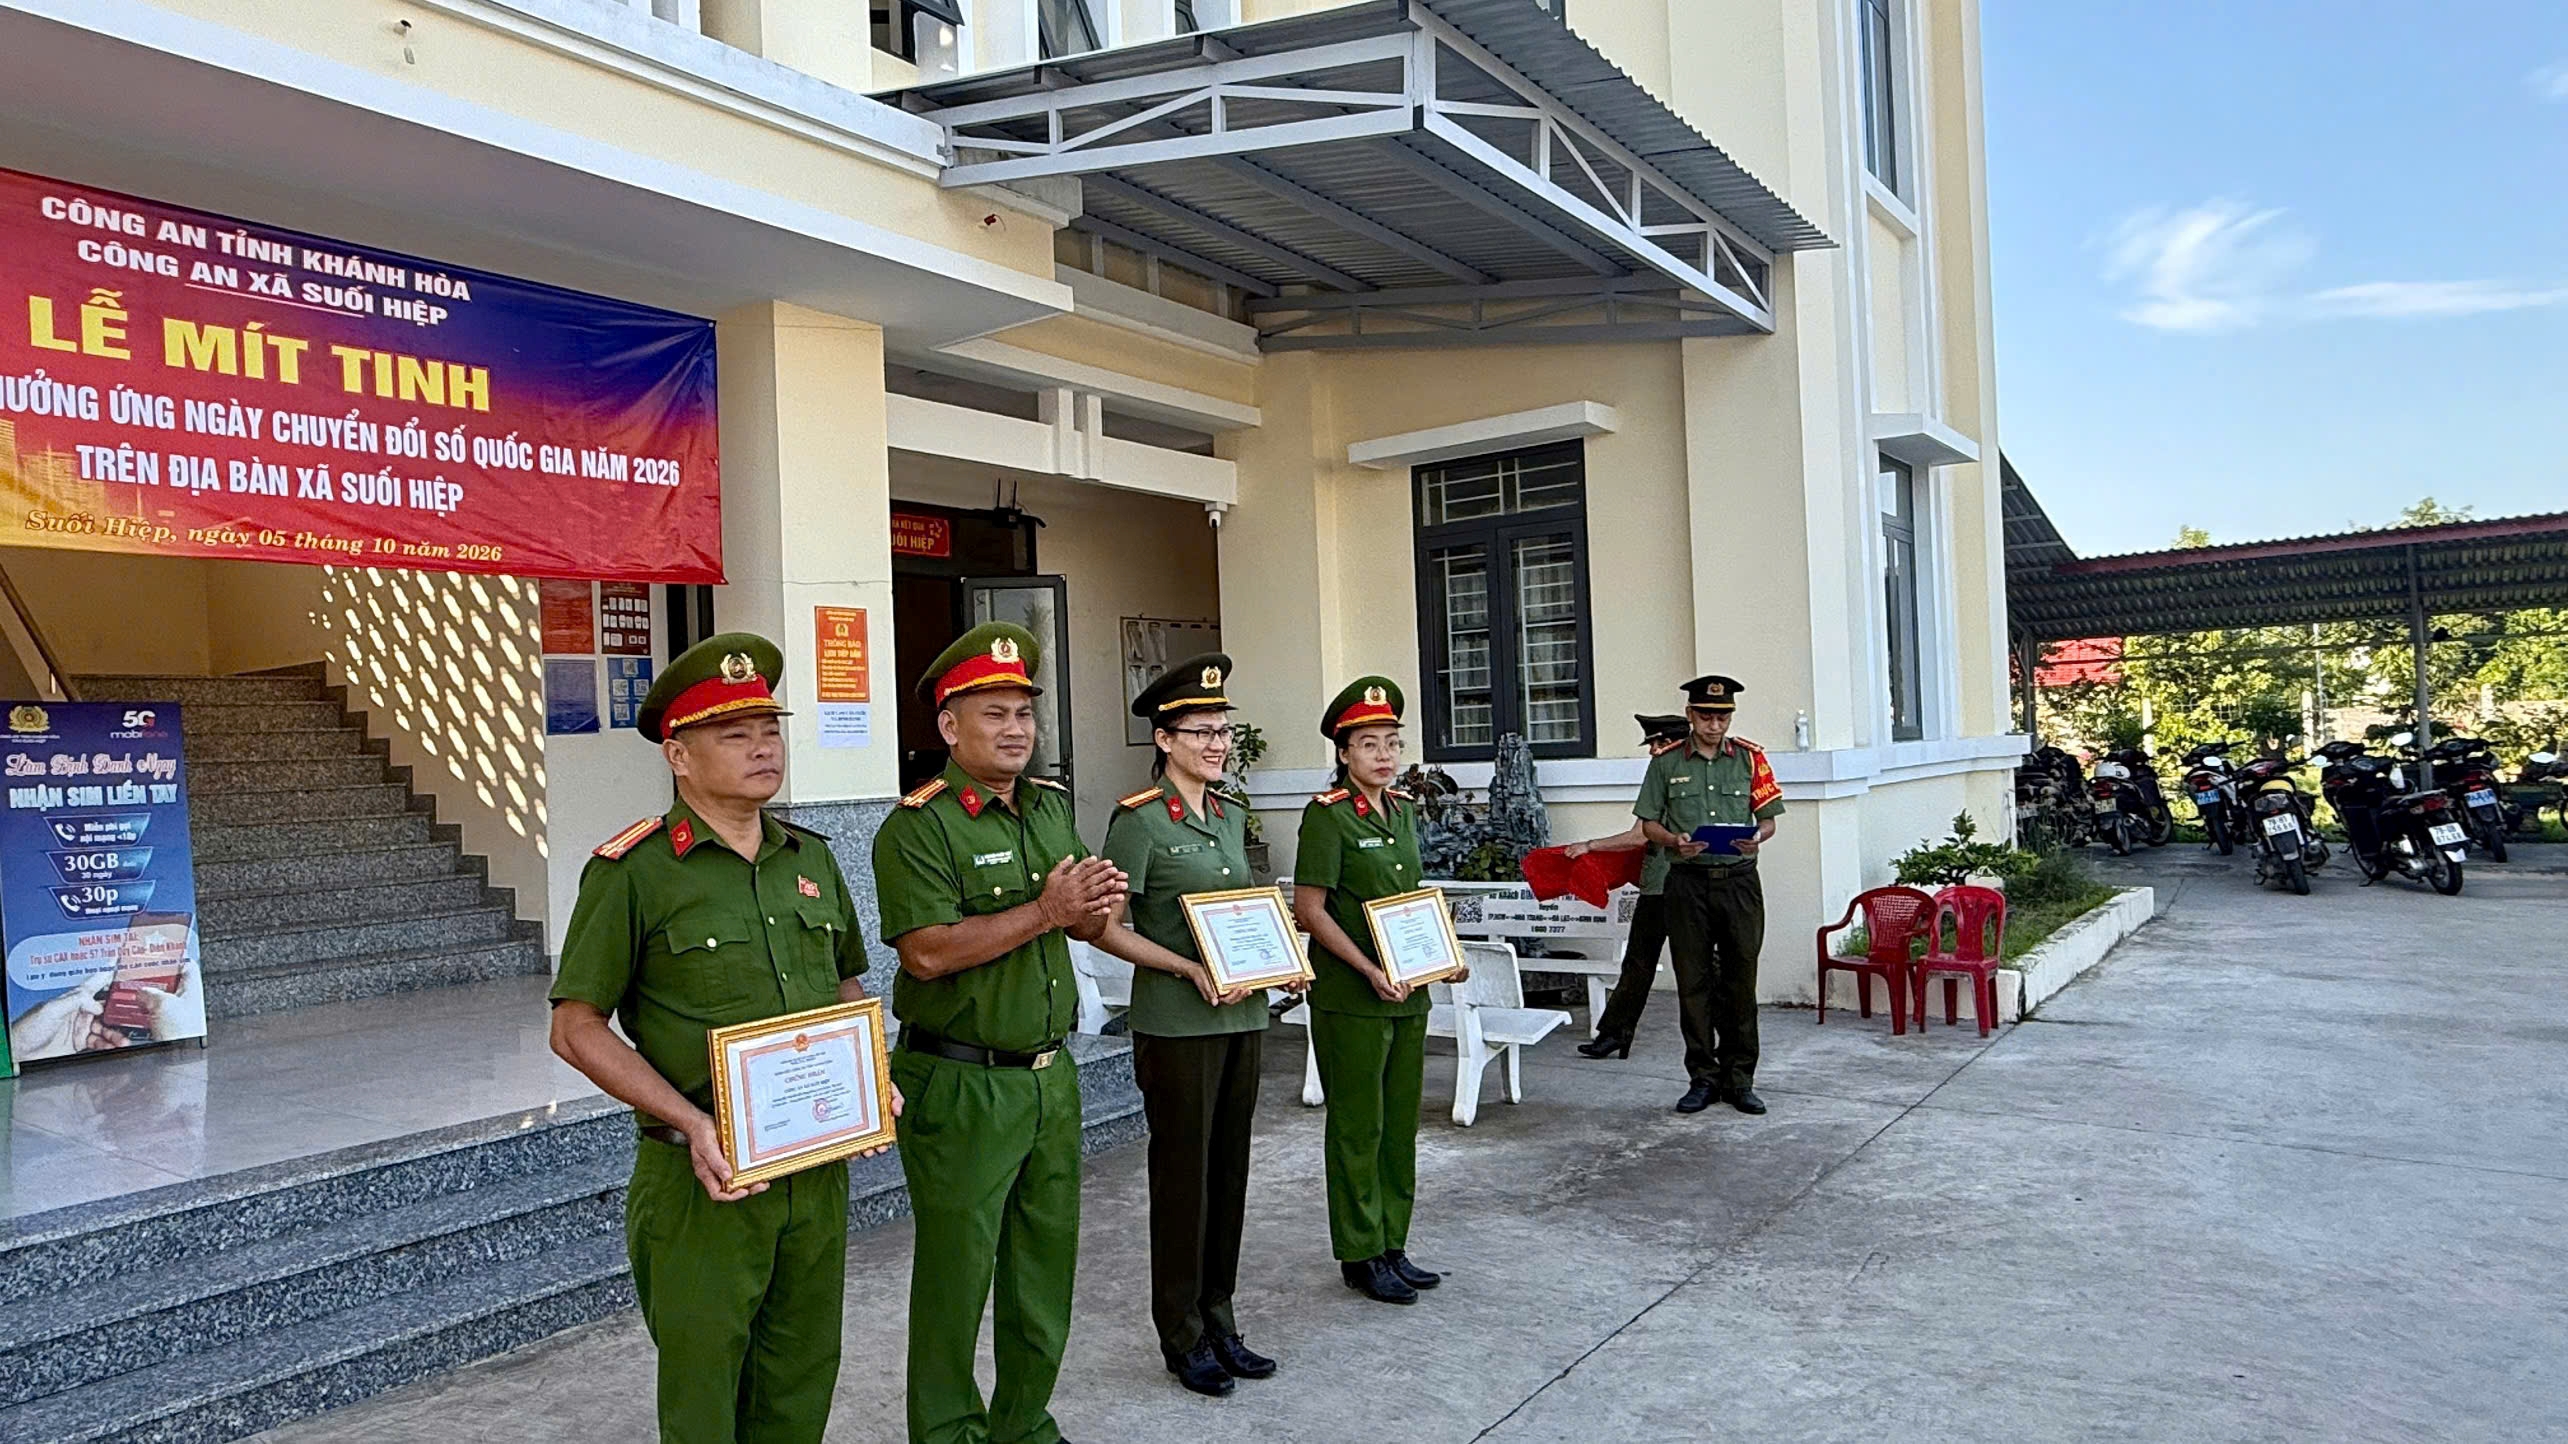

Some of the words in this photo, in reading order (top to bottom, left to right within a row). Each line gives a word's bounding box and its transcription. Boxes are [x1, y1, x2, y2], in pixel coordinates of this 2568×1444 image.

[41, 196, 146, 237] CÔNG
[156, 220, 207, 249] AN
[216, 229, 292, 266] TỈNH
[302, 249, 406, 289] KHÁNH
[414, 271, 472, 302] HÒA
[77, 239, 180, 278] CÔNG
[190, 261, 238, 288] AN
[248, 271, 294, 299] XÃ
[302, 281, 374, 314] SUỐI
[383, 296, 448, 327] HIỆP
[29, 287, 131, 360] LỄ
[163, 317, 309, 385] MÍT
[331, 344, 489, 412] TINH
[0, 368, 100, 421] ƯỞNG
[109, 383, 175, 430] ỨNG
[184, 398, 264, 440] NGÀY
[272, 408, 378, 454] CHUYỂN
[385, 416, 428, 459] ĐỔI
[434, 423, 466, 463] SỐ
[473, 431, 534, 471] QUỐC
[539, 444, 576, 477] GIA
[581, 446, 629, 482] NĂM
[632, 457, 681, 487] 2026
[75, 442, 159, 486] TRÊN
[168, 454, 221, 497] ĐỊA
[229, 456, 289, 497] BÀN
[296, 463, 334, 502] XÃ
[341, 465, 401, 508] SUỐI
[408, 475, 464, 517] HIỆP
[25, 510, 96, 534] Suối
[103, 516, 177, 544] Hiệp,
[187, 526, 250, 548] ngày
[258, 529, 287, 548] 05
[294, 529, 362, 554] tháng
[372, 537, 396, 554] 10
[402, 539, 450, 558] năm
[457, 543, 503, 562] 2026
[910, 534, 935, 552] HIỆP
[122, 710, 156, 728] 5G
[9, 784, 64, 811] NHẬN
[67, 785, 103, 807] SIM
[150, 783, 178, 804] TAY
[1752, 783, 1775, 800] TRỰC
[64, 853, 119, 872] 30GB
[81, 886, 119, 905] 30p
